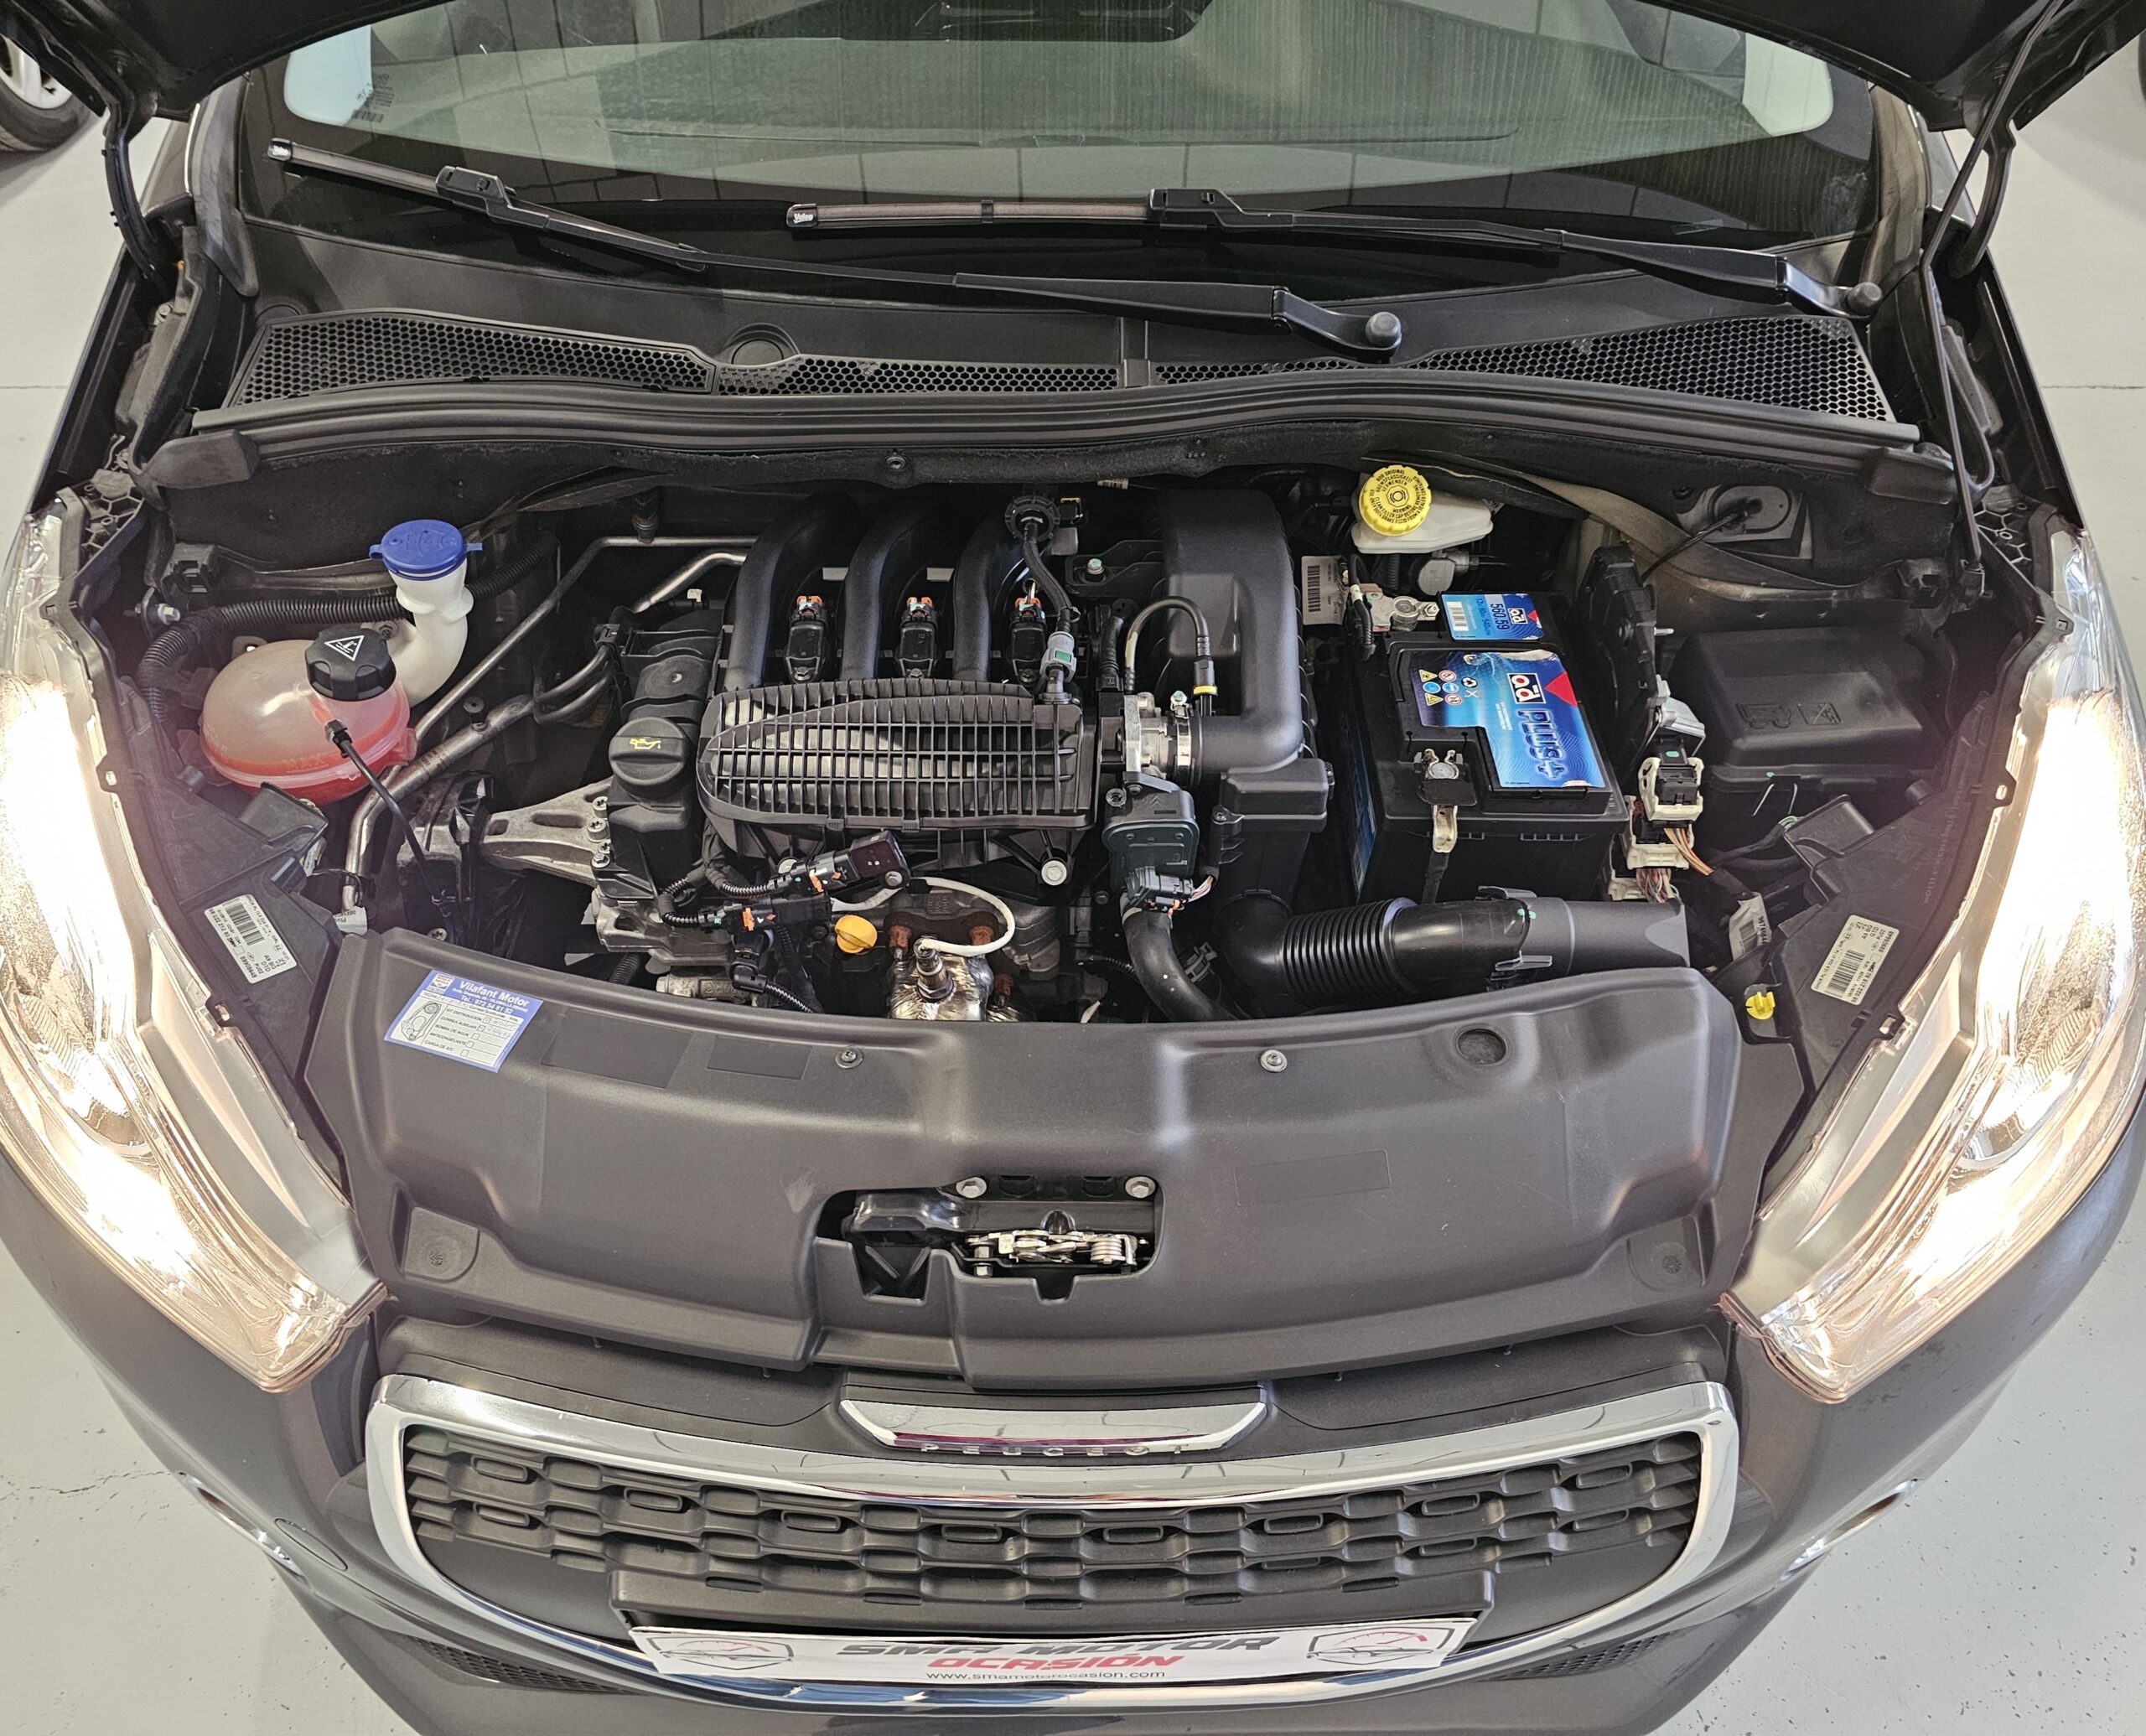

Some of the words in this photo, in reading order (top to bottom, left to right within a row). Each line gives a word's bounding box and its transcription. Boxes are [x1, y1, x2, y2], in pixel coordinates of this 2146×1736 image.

[1382, 479, 1407, 492] VERWENDEN
[1375, 497, 1383, 510] CLEAN
[1382, 508, 1396, 518] FILLER
[1404, 505, 1418, 517] BEFORE
[1490, 604, 1509, 630] 560.59
[459, 981, 498, 998] Vilafant
[498, 993, 531, 1007] Motor
[920, 1443, 1190, 1457] PEUGEOT
[1016, 1636, 1280, 1656] MOTOR
[927, 1653, 1185, 1670] OCASIÓN
[926, 1671, 1165, 1680] www.smamotorocasion.com
